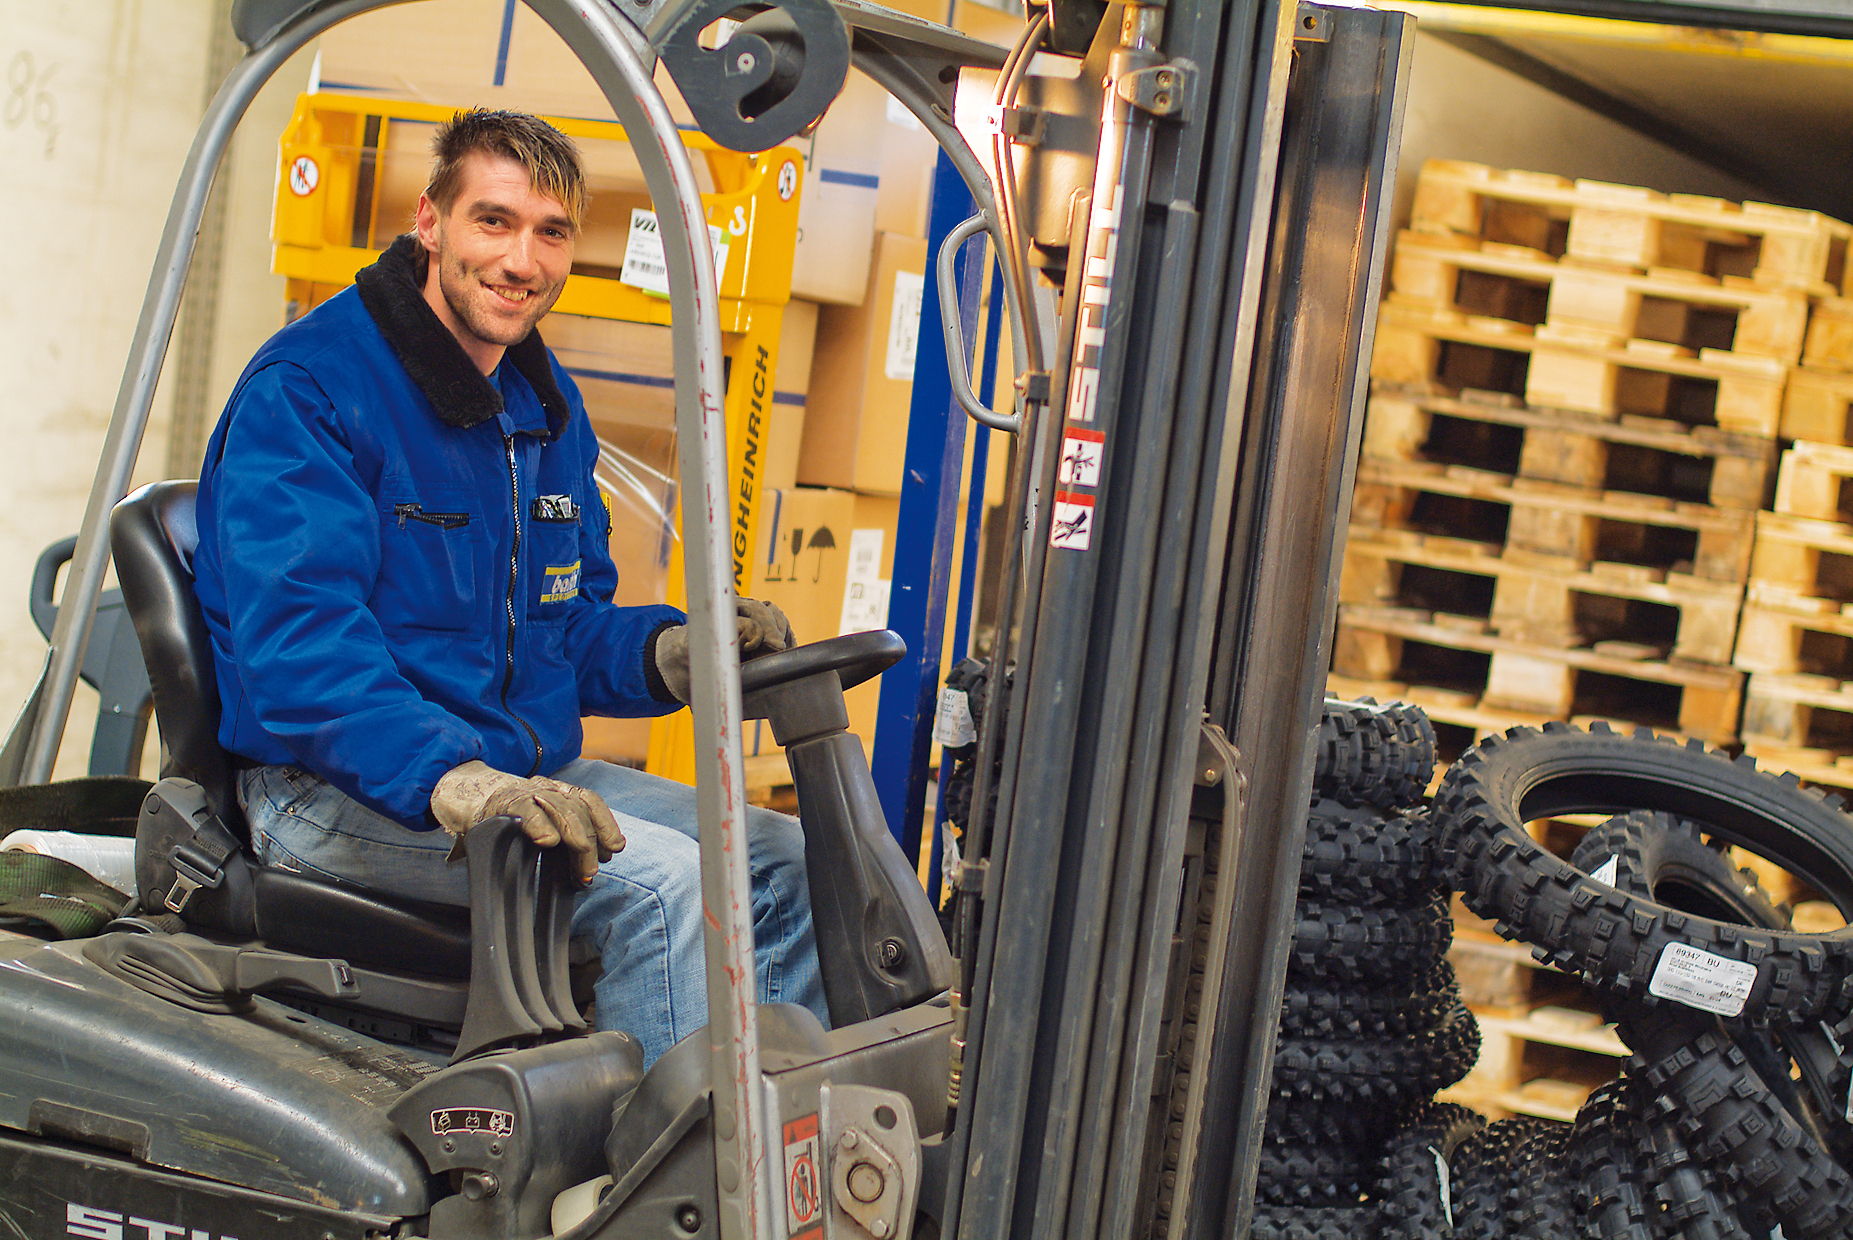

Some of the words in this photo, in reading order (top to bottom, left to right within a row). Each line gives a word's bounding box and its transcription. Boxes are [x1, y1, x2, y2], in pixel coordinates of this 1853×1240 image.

[634, 216, 657, 233] VIL
[1069, 184, 1125, 423] STILL
[733, 344, 770, 594] NGHEINRICH
